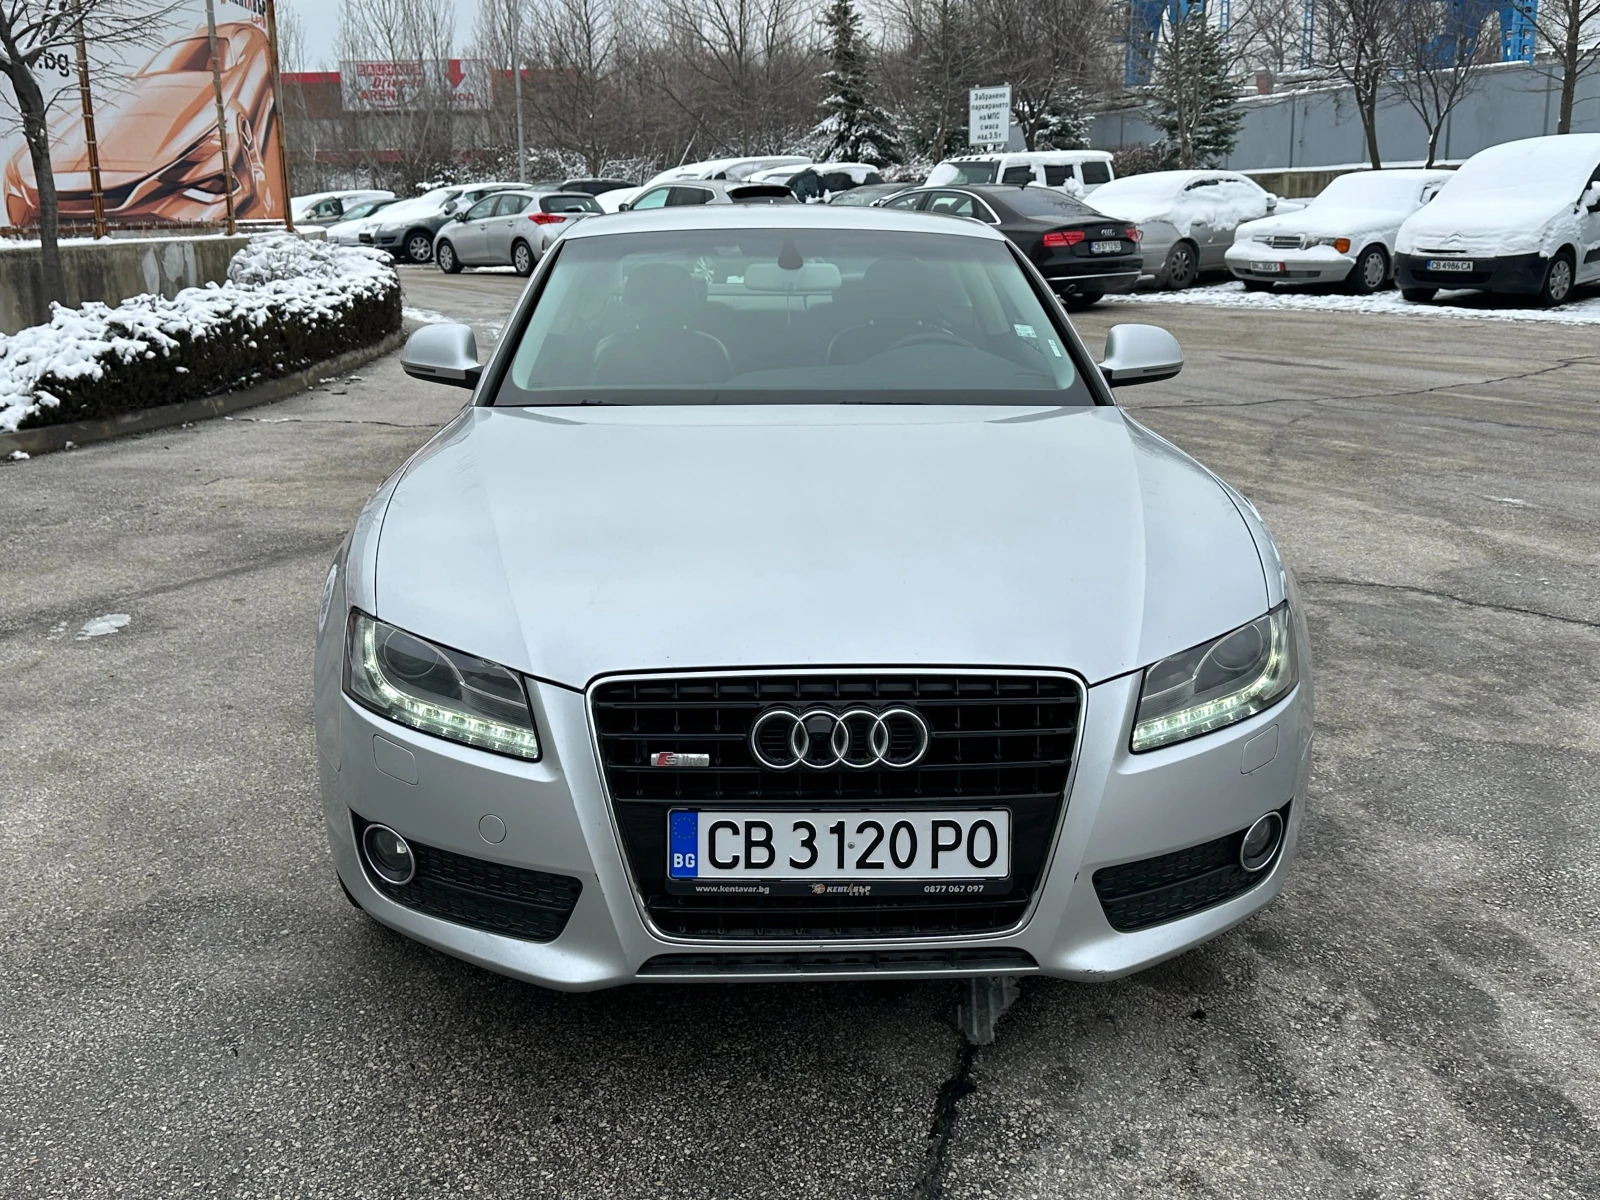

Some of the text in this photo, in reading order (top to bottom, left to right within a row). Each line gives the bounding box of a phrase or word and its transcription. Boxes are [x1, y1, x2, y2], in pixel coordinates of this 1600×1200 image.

[974, 92, 1007, 101] Забранено
[971, 102, 1009, 111] паркирането
[987, 112, 1000, 120] МПС
[1442, 261, 1460, 270] 4986
[708, 820, 776, 870] CB
[789, 820, 918, 870] 3120
[673, 853, 696, 868] BG
[695, 885, 770, 894] www.kentavar.bg
[924, 885, 984, 893] 0877 067 097
